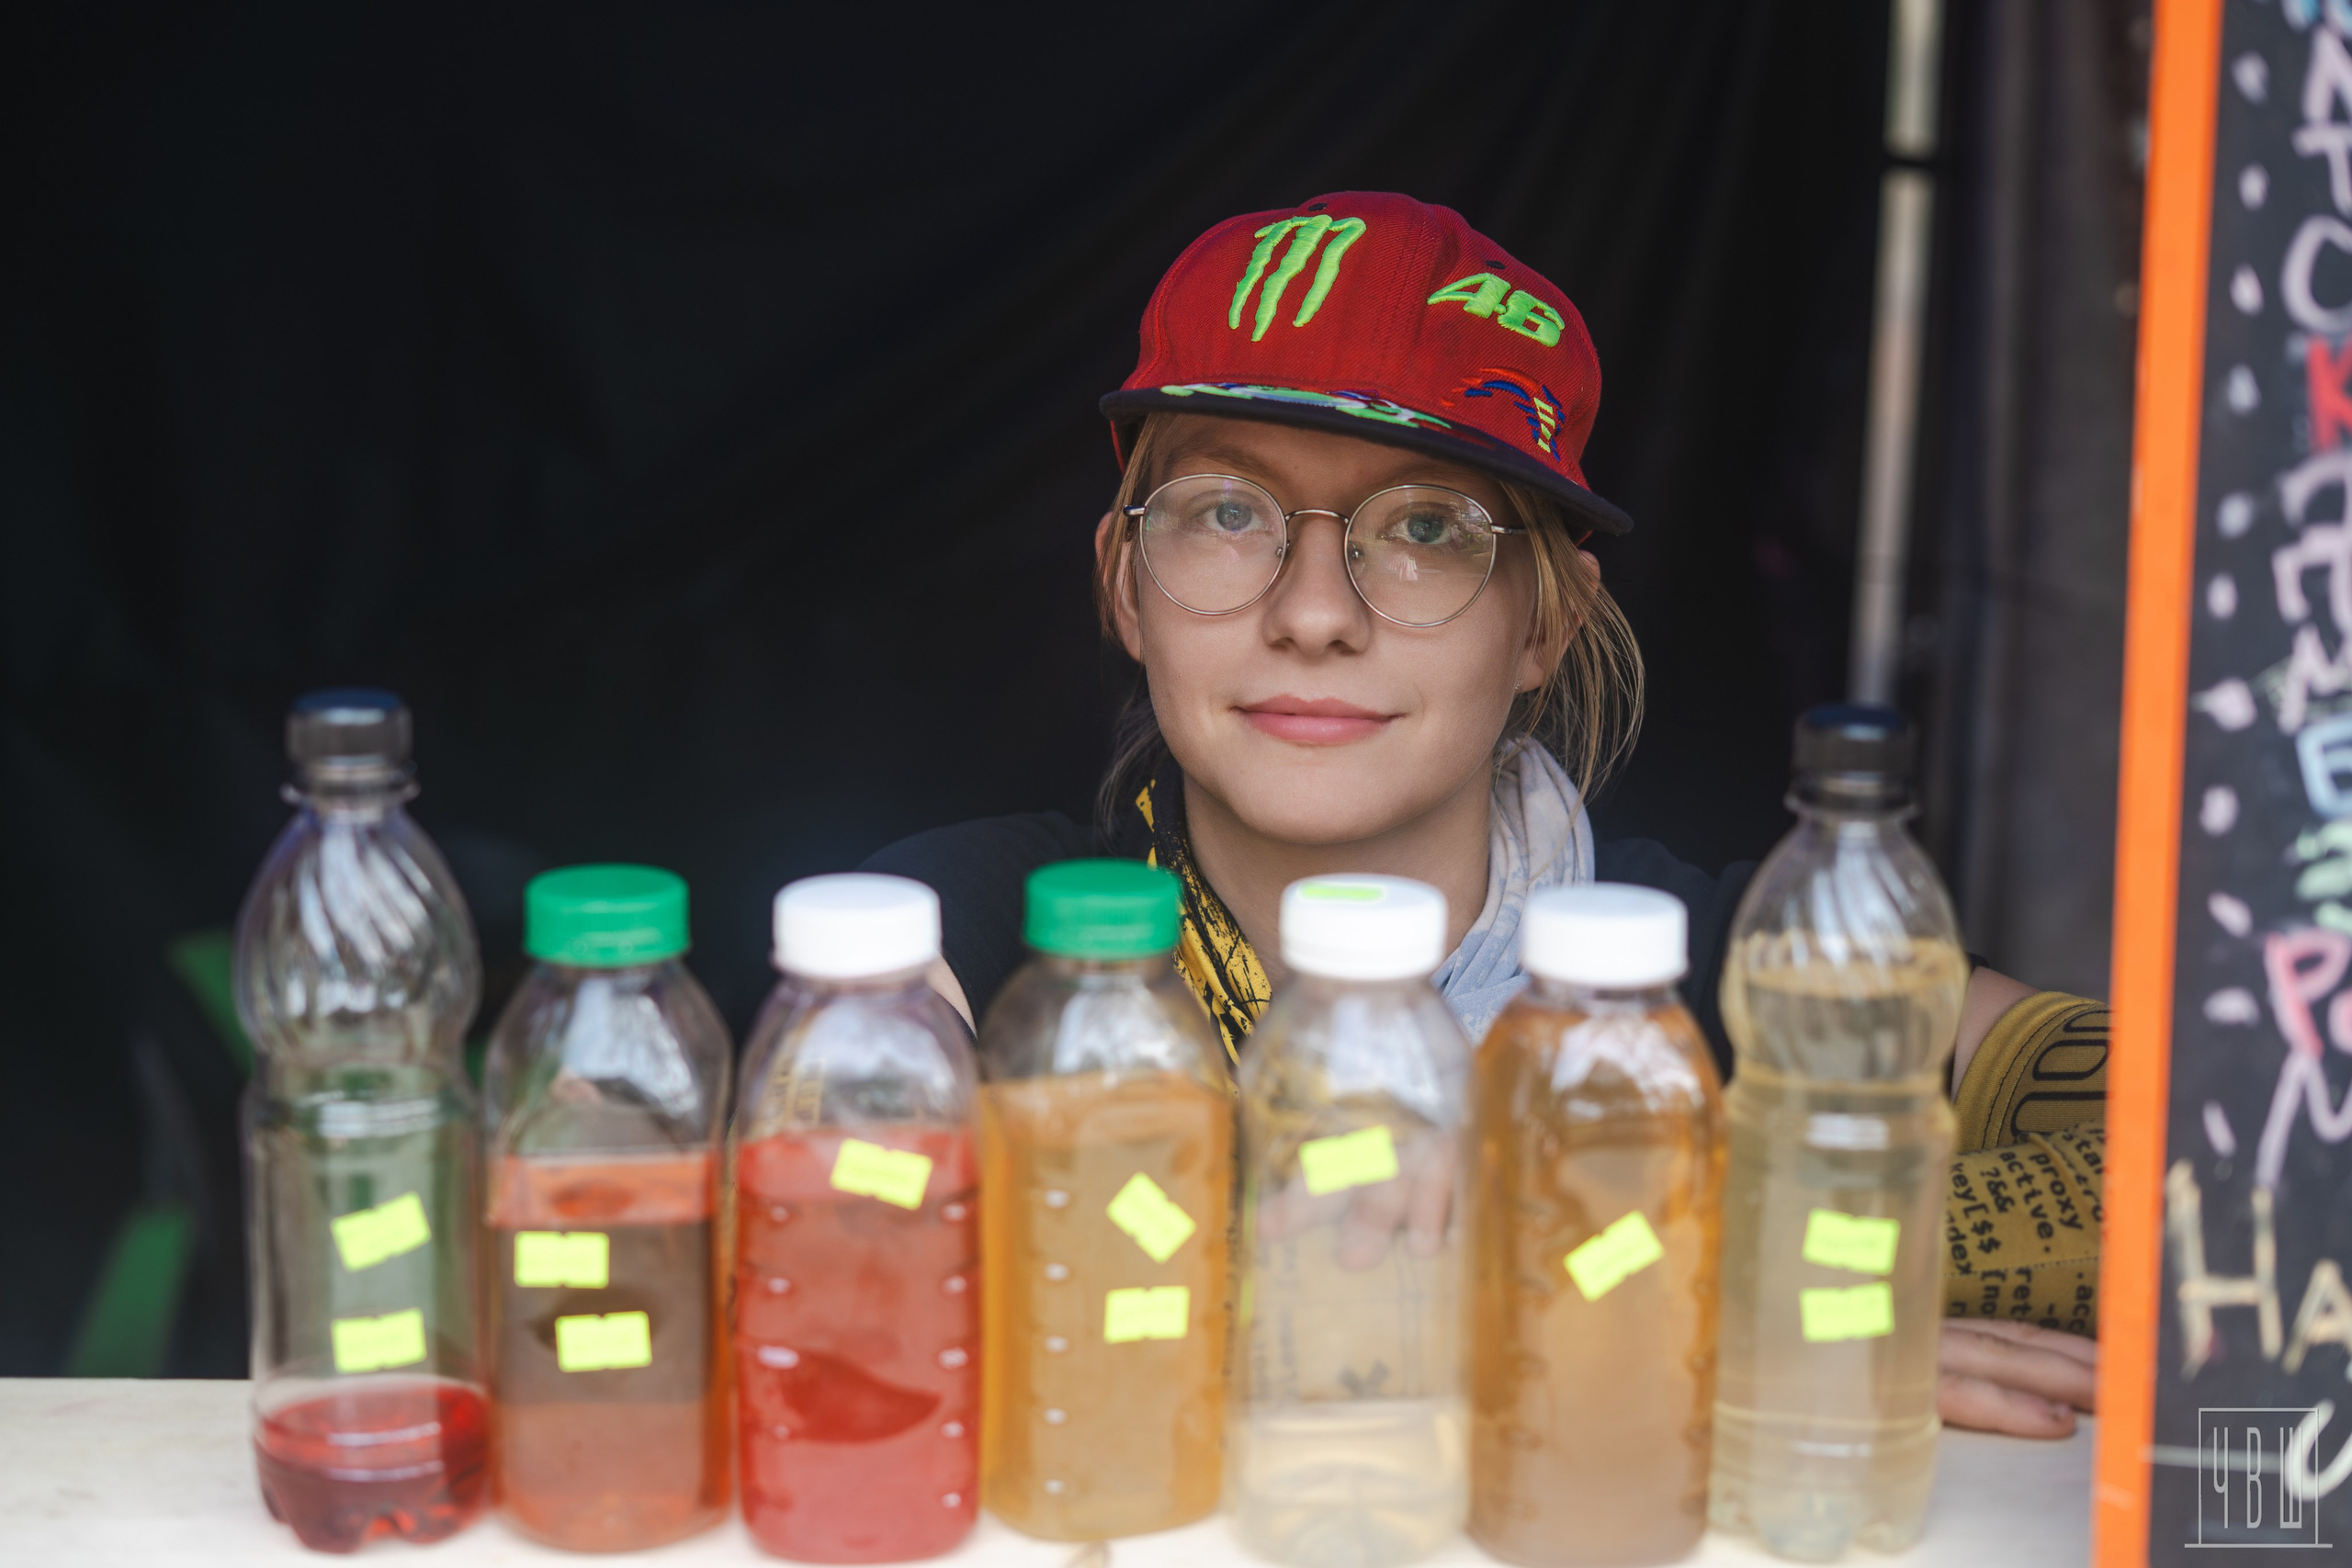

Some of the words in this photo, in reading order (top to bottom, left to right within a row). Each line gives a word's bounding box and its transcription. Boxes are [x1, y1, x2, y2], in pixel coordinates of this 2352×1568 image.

[1426, 272, 1566, 347] 46
[1999, 1151, 2054, 1253] active.
[2028, 1152, 2084, 1230] proxy
